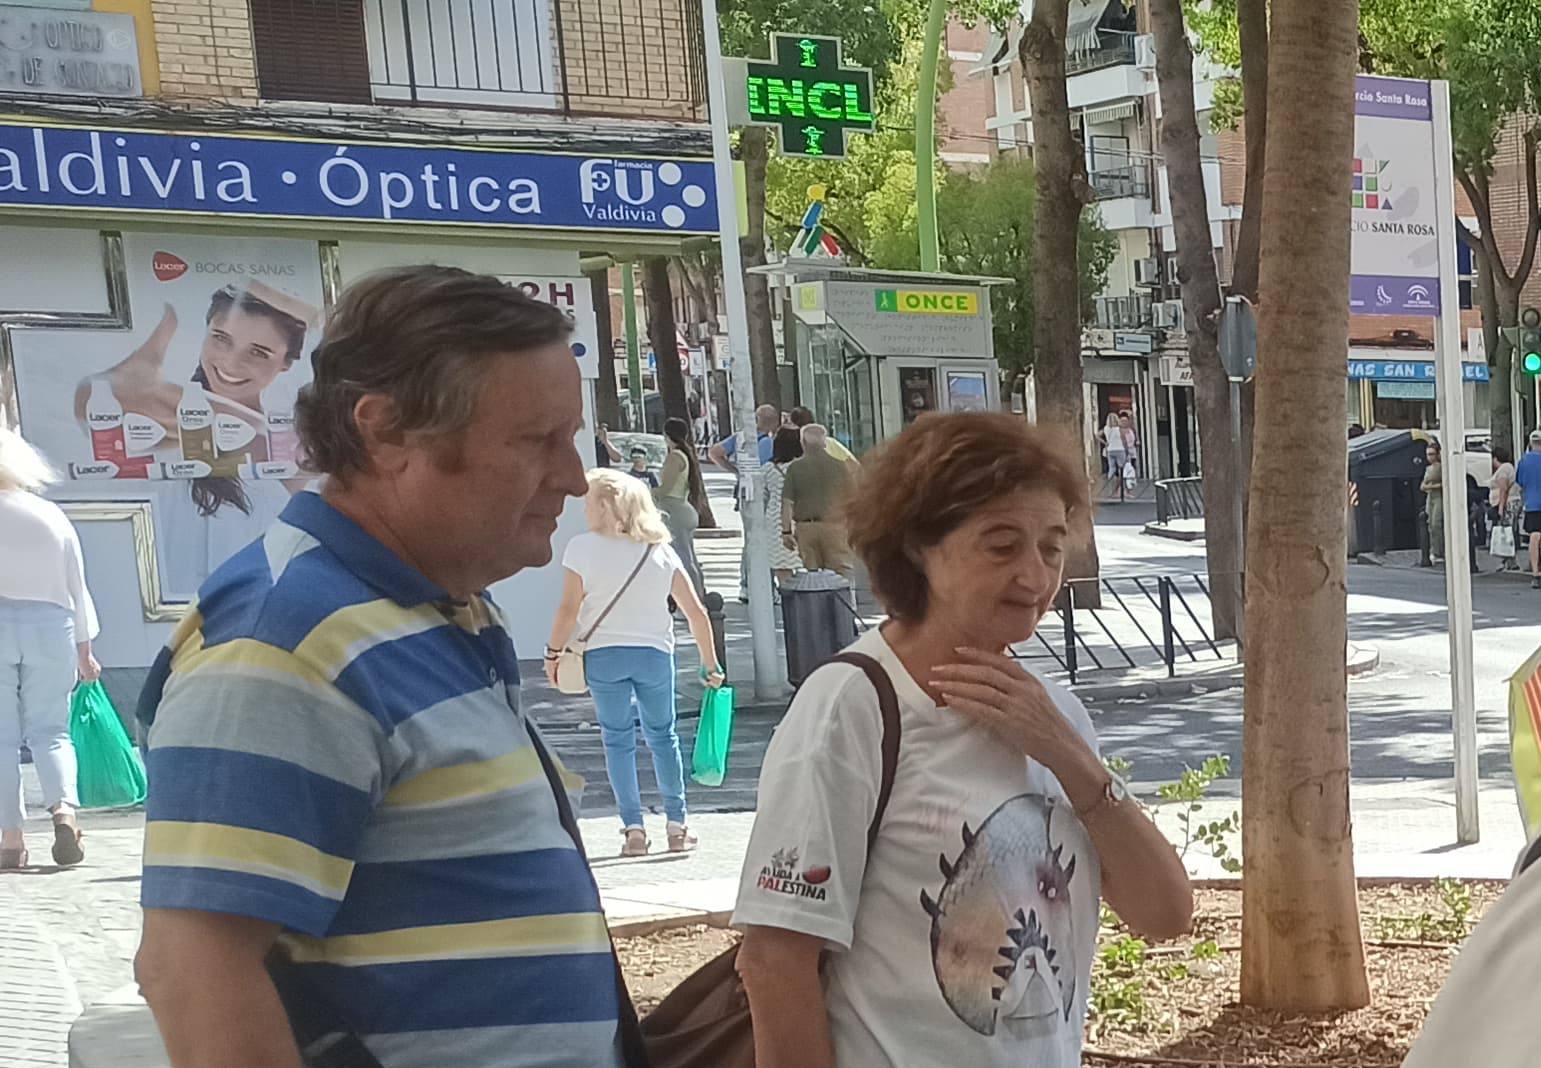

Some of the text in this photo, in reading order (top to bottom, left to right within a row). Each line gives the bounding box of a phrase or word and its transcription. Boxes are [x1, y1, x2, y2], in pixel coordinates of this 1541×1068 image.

[748, 77, 873, 121] INCL
[1376, 91, 1402, 105] Santa
[1405, 94, 1427, 107] Rosa
[319, 146, 541, 219] Óptica
[582, 203, 656, 222] Valdivia
[1372, 221, 1404, 235] SANTA
[1407, 224, 1435, 237] ROSA
[154, 261, 296, 277] Lacer BOCAS SANAS
[549, 283, 574, 306] H
[905, 294, 969, 311] ONCE
[1384, 364, 1415, 377] SAN
[89, 413, 121, 422] Lacer
[180, 408, 211, 417] Lacer
[76, 466, 110, 475] Lacer
[757, 876, 826, 901] PALESTINA
